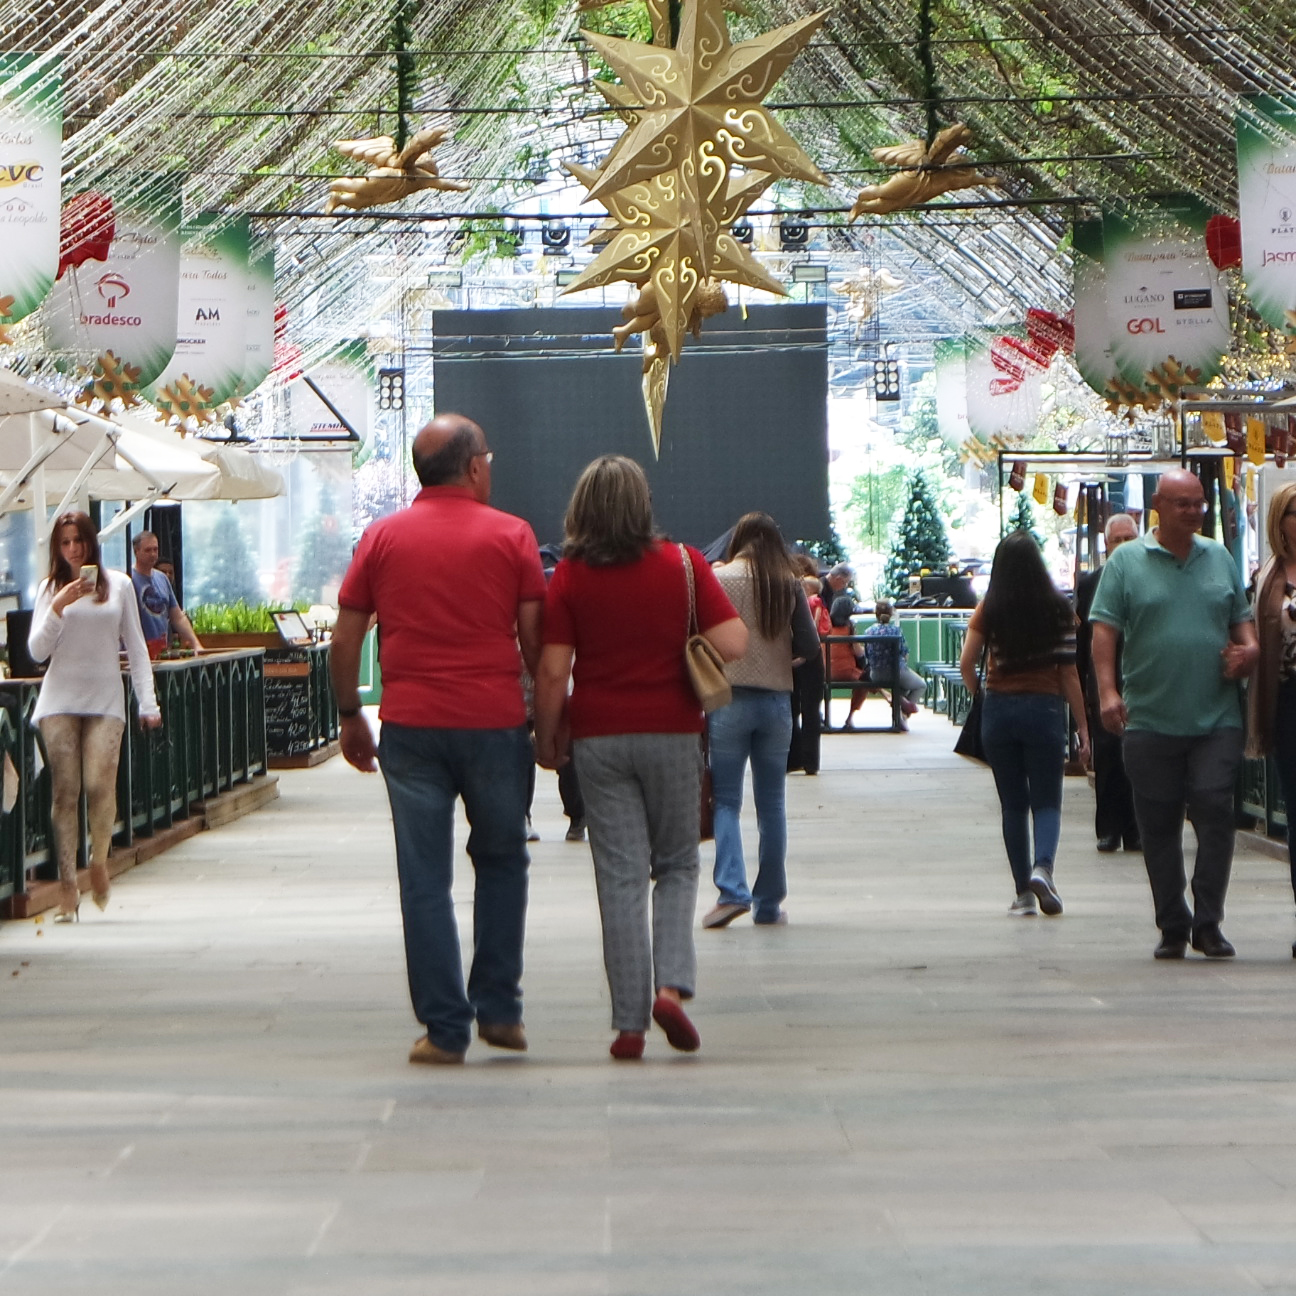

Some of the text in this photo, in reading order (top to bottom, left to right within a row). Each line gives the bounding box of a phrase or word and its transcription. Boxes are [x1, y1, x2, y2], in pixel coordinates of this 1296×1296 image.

[1124, 294, 1165, 304] LUGANO
[79, 313, 142, 327] bradesco
[195, 307, 220, 321] AM
[1127, 317, 1166, 335] GOL
